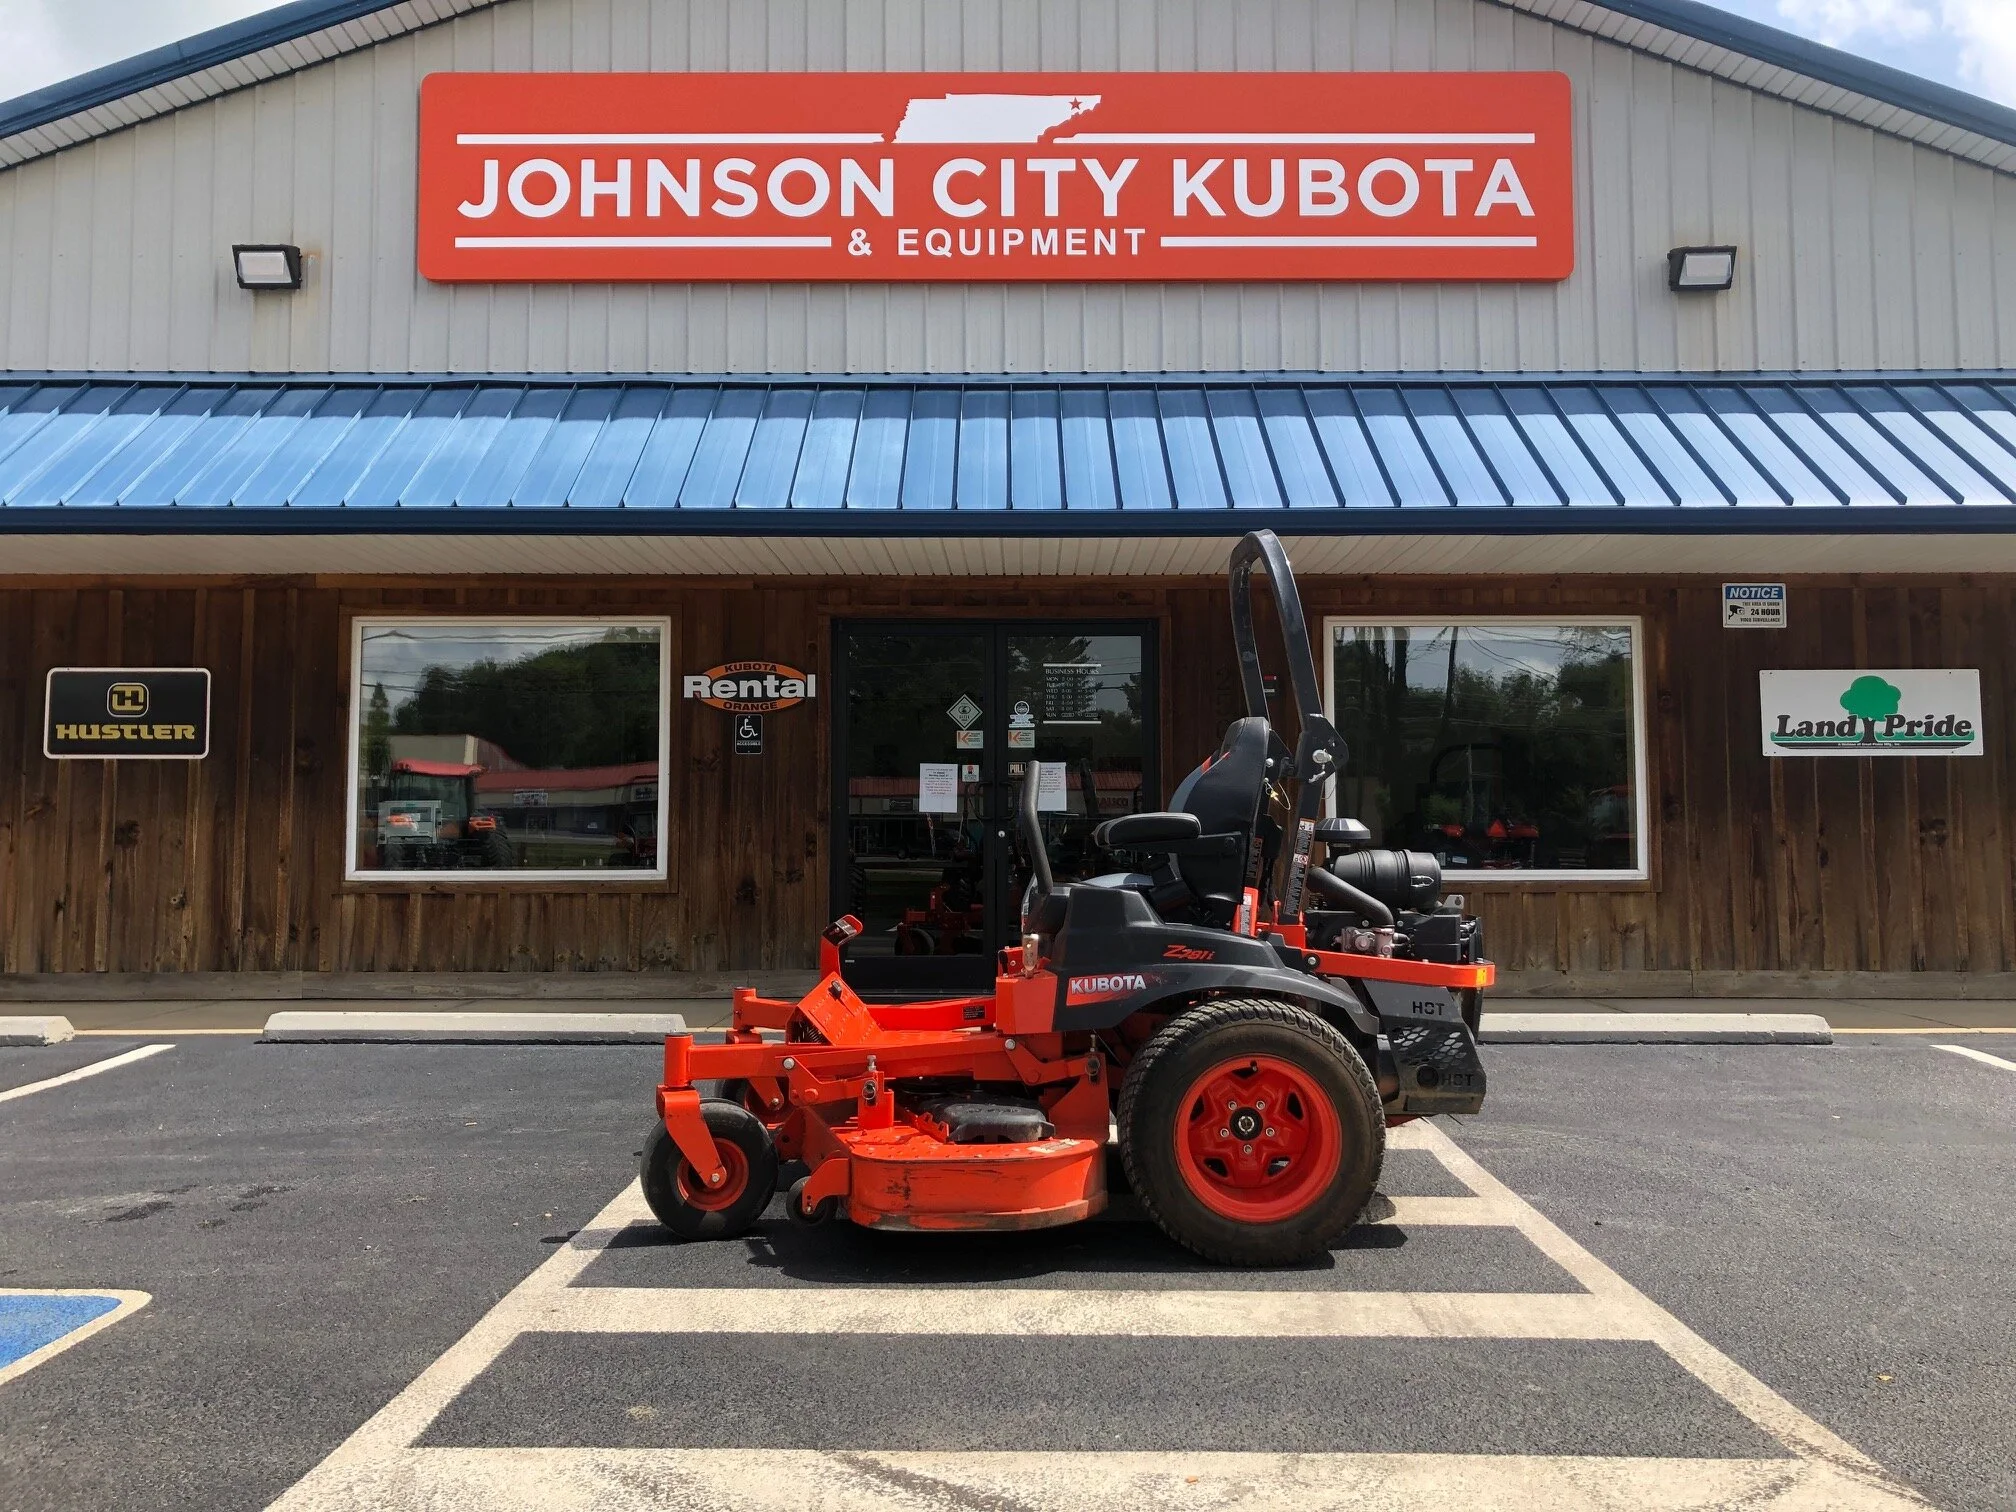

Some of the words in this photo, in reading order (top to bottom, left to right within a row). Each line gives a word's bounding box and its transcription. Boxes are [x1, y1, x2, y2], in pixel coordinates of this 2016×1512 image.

[456, 157, 895, 219] JOHNSON
[932, 157, 1140, 218] CITY
[1173, 157, 1536, 218] KUBOTA
[847, 228, 873, 256] &
[898, 228, 1146, 258] EQUIPMENT
[1729, 587, 1780, 599] NOTICE
[1750, 608, 1760, 616] 24
[1761, 608, 1781, 616] HOUR
[724, 663, 778, 673] KUBOTA
[683, 674, 816, 699] Rental
[722, 702, 778, 711] ORANGE
[55, 724, 196, 740] HUSTLER
[1774, 714, 1859, 737] Land
[1882, 714, 1972, 737] Pride
[1009, 763, 1025, 774] PULL
[1071, 975, 1147, 995] KUBOTA
[1412, 1001, 1445, 1015] HOT
[1441, 1073, 1474, 1086] HOT
